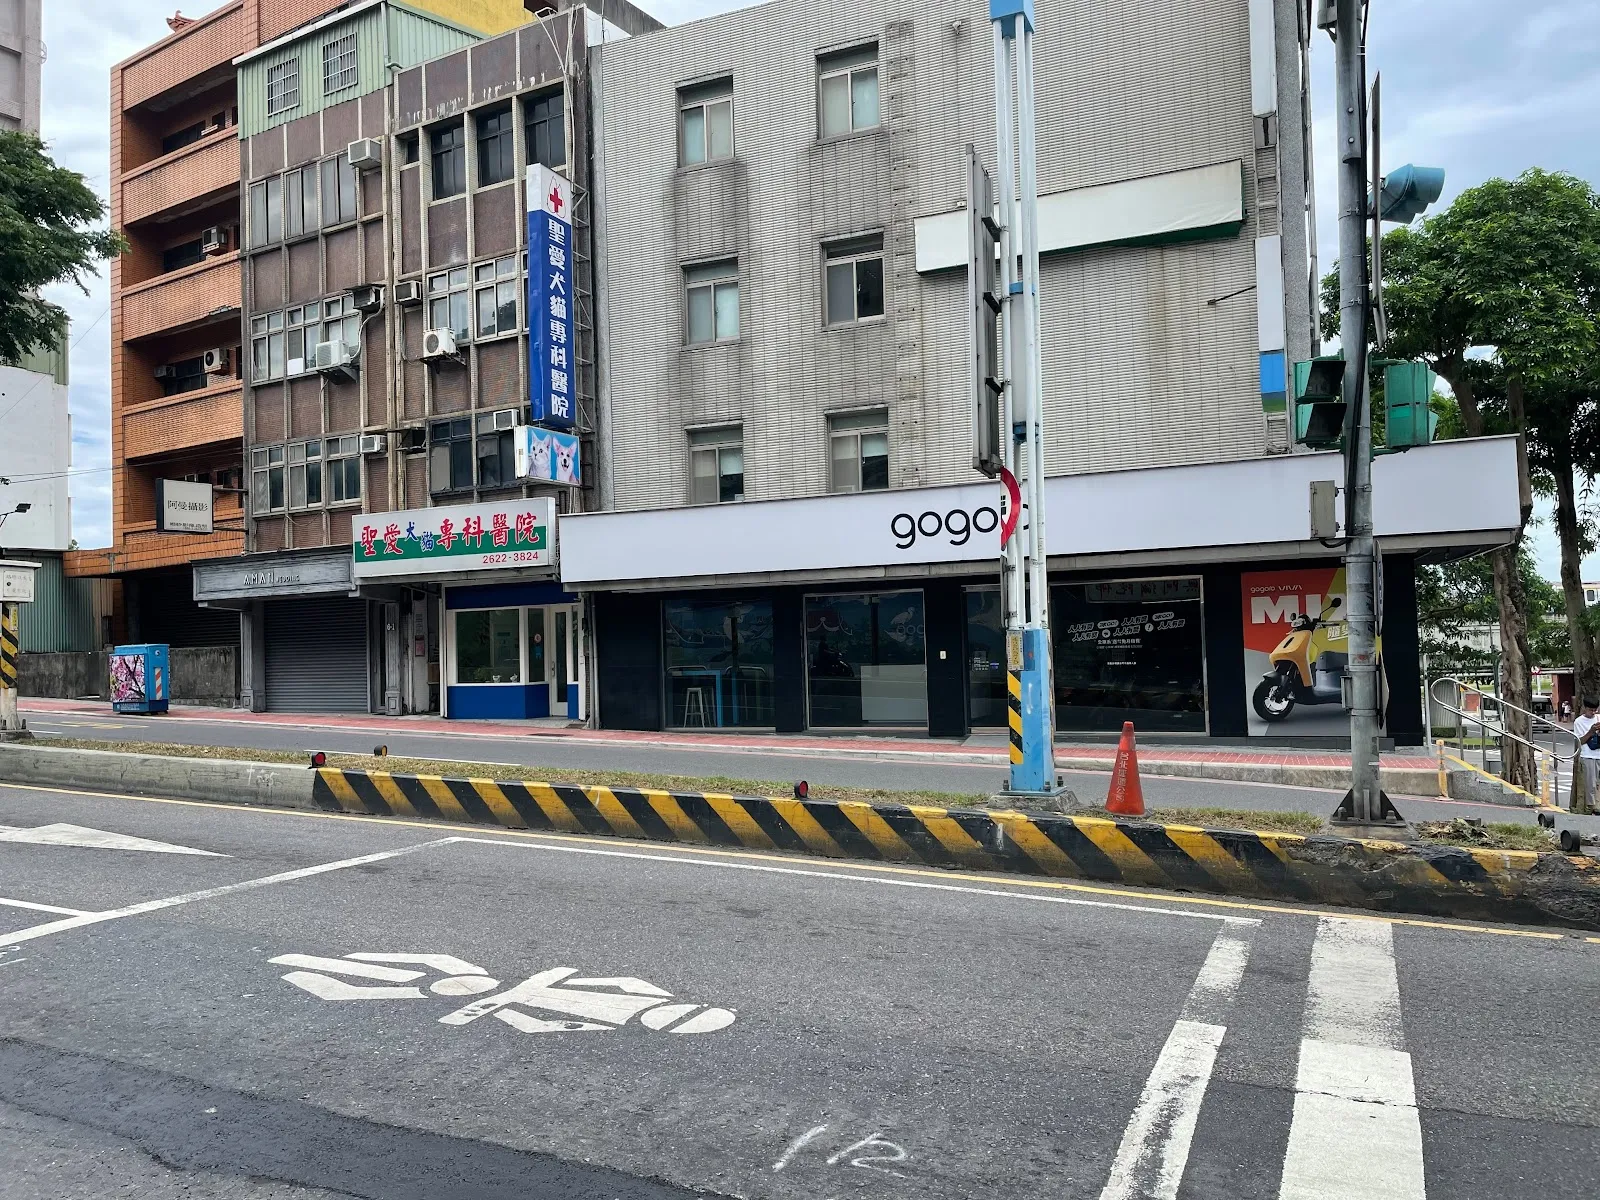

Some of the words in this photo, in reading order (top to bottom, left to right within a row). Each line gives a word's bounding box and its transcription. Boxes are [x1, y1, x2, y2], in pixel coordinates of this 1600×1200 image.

[548, 218, 569, 420] 聖愛犬貓專科醫院
[361, 512, 540, 557] 聖愛犬貓專科醫院
[891, 503, 1029, 549] gogo
[482, 551, 539, 564] 2622-3824
[1250, 586, 1275, 594] gogoro
